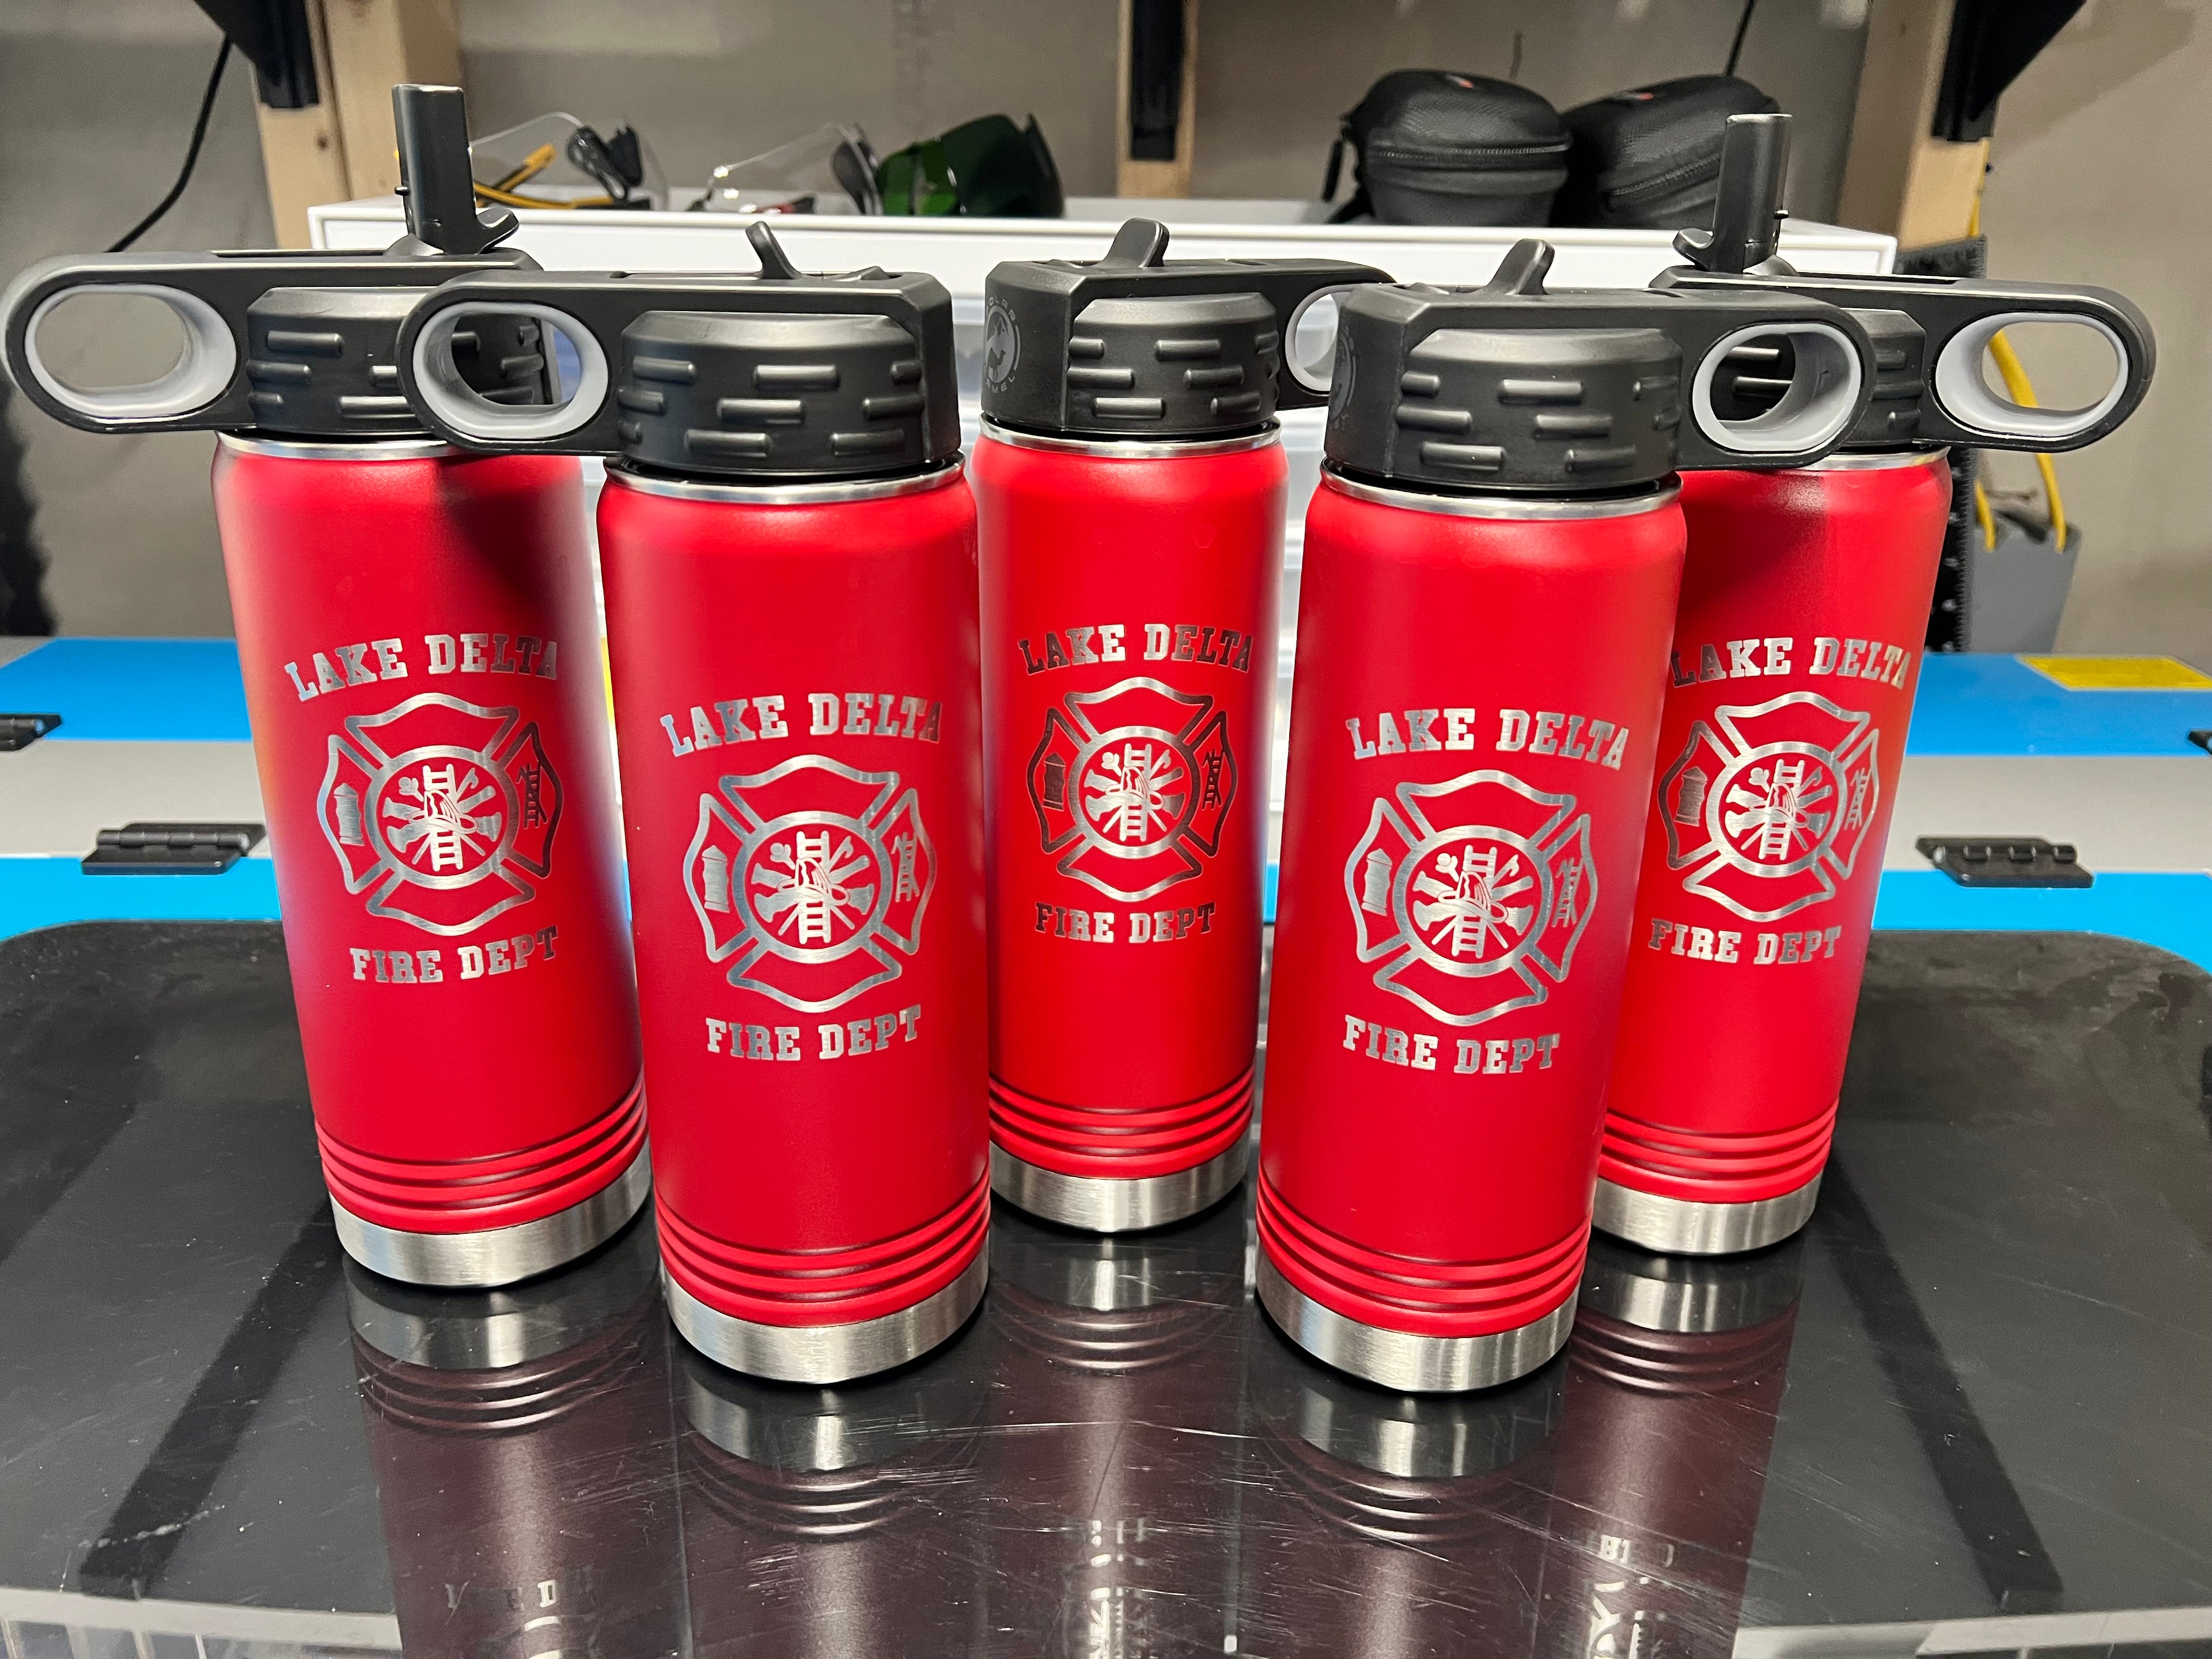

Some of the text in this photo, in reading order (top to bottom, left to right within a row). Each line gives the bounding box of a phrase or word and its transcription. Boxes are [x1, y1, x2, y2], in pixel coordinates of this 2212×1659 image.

[986, 294, 1016, 321] OLAR
[986, 376, 1015, 393] AMEL
[285, 634, 558, 702] LAKE DELTA
[1017, 623, 1253, 676] LAKE DELTA
[1671, 637, 1911, 690] LAKE DELTA
[660, 693, 942, 757] LAKE DELTA
[1346, 708, 1629, 770] LAKE DELTA
[1035, 902, 1215, 944] FIRE DEPT
[1648, 919, 1841, 965] FIRE DEPT
[350, 925, 558, 983] FIRE DEPT
[706, 1004, 921, 1060] FIRE DEPT
[1343, 1014, 1560, 1074] FIRE DEPT
